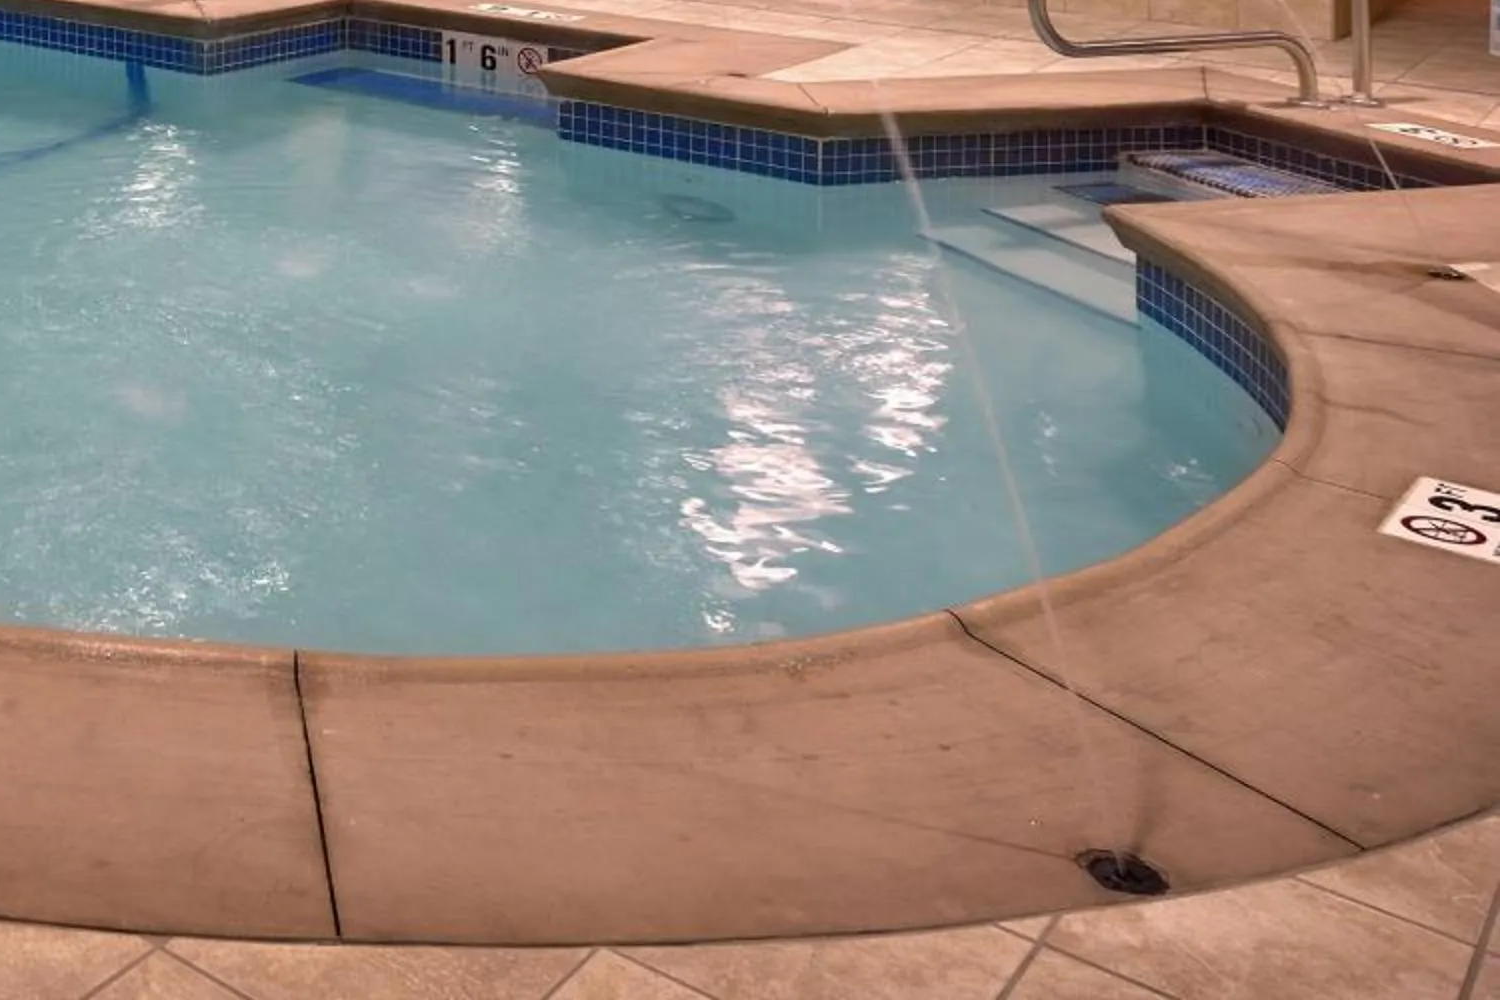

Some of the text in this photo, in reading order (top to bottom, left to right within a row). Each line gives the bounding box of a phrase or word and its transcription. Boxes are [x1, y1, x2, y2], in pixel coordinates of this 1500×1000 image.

[446, 39, 456, 64] 1
[481, 45, 496, 70] 6
[1428, 495, 1500, 522] 3
